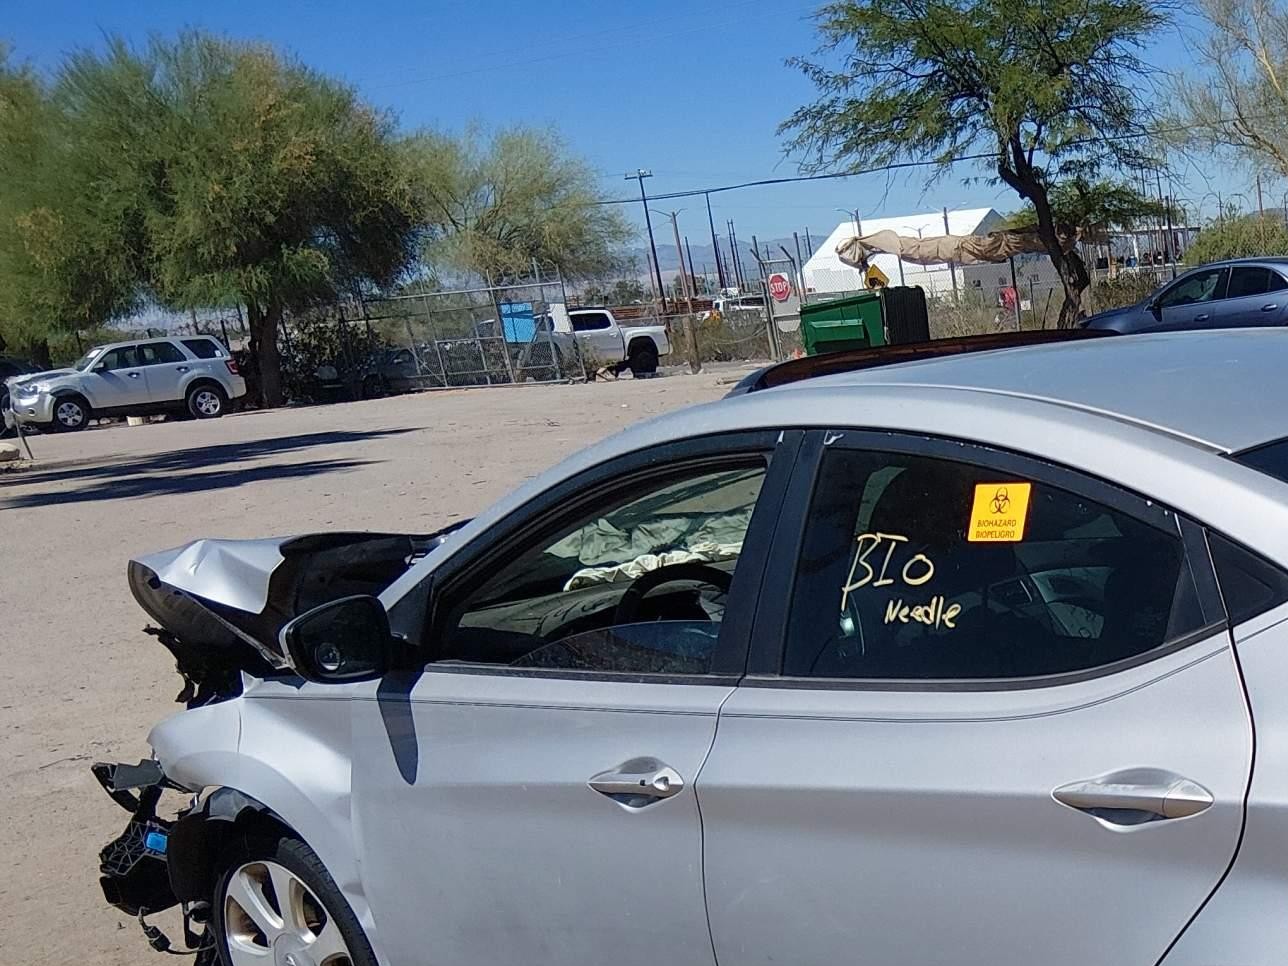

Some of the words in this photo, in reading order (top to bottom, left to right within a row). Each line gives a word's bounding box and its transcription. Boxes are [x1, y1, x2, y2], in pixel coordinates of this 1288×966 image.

[771, 281, 787, 293] STOP
[976, 519, 1017, 528] BIOHAZARD
[975, 530, 1015, 539] BIOPELIGRO
[841, 532, 935, 612] BIO
[884, 596, 962, 630] Needle
